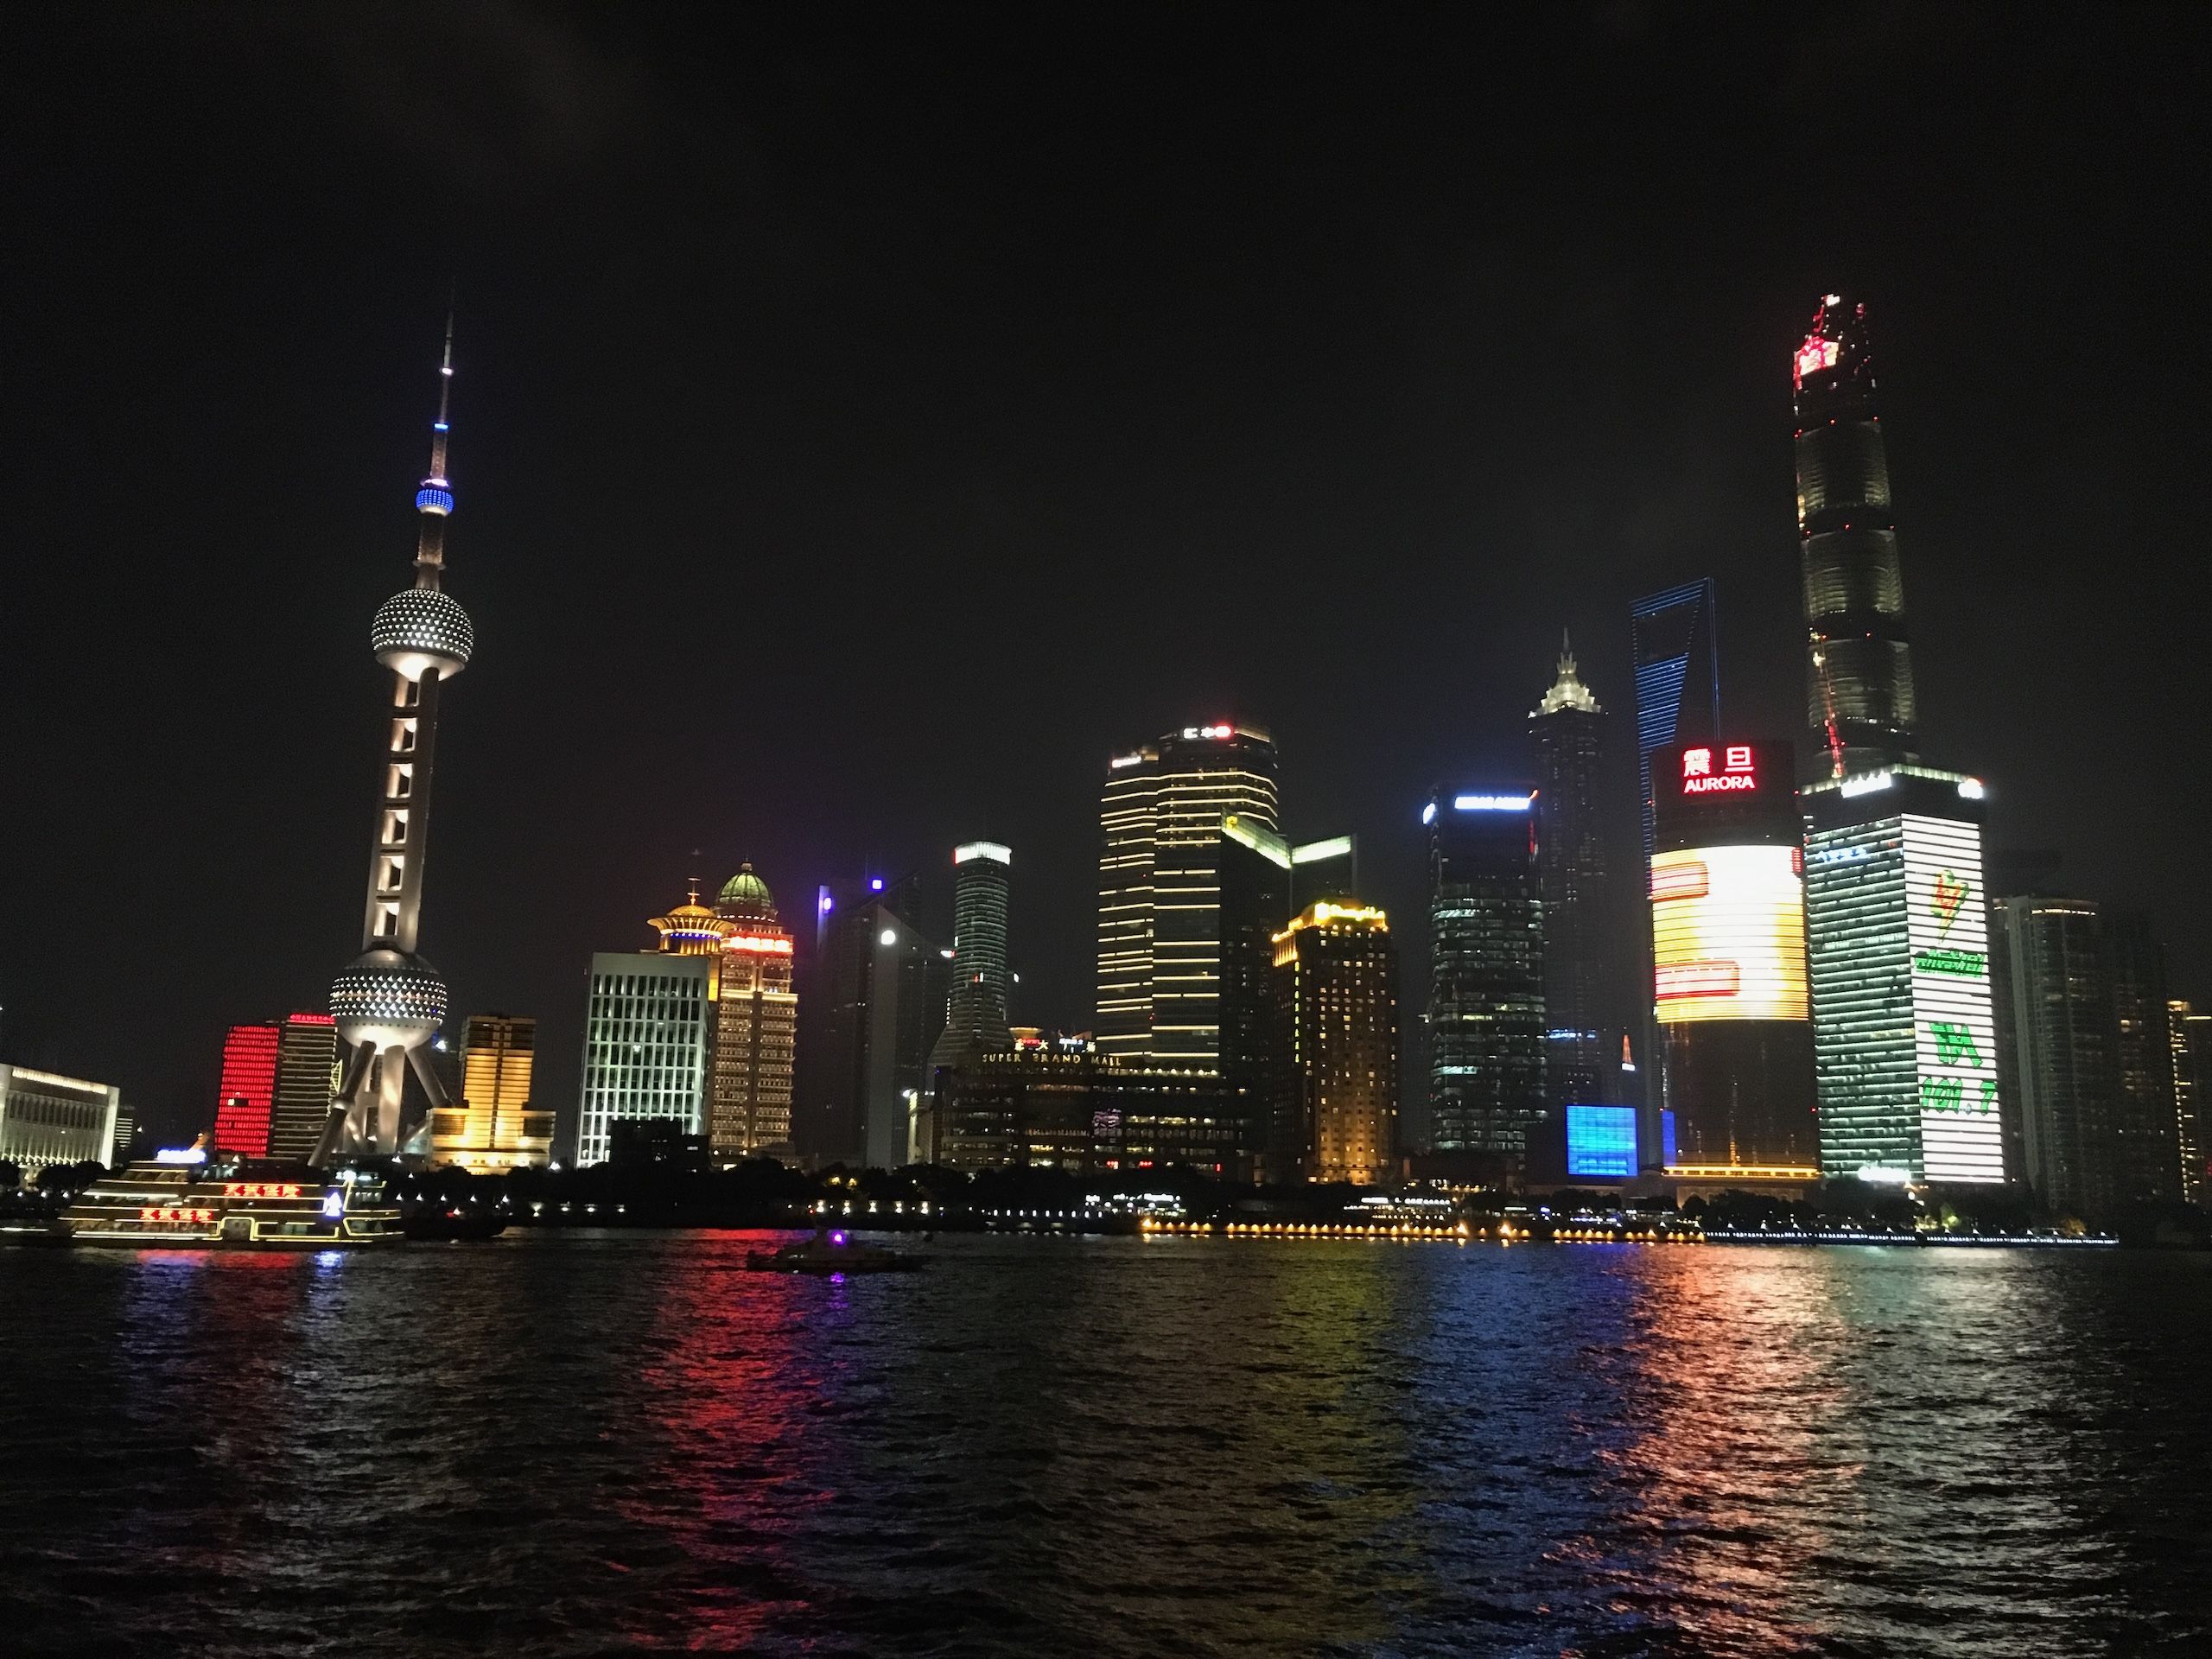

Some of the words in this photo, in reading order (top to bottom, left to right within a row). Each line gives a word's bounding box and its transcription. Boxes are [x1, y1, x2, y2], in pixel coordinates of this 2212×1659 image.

[1684, 747, 1755, 777] 震旦
[1684, 776, 1755, 793] AURORA
[982, 1053, 1021, 1064] SUPER
[1032, 1053, 1081, 1064] BRAND
[1090, 1056, 1122, 1066] MALL
